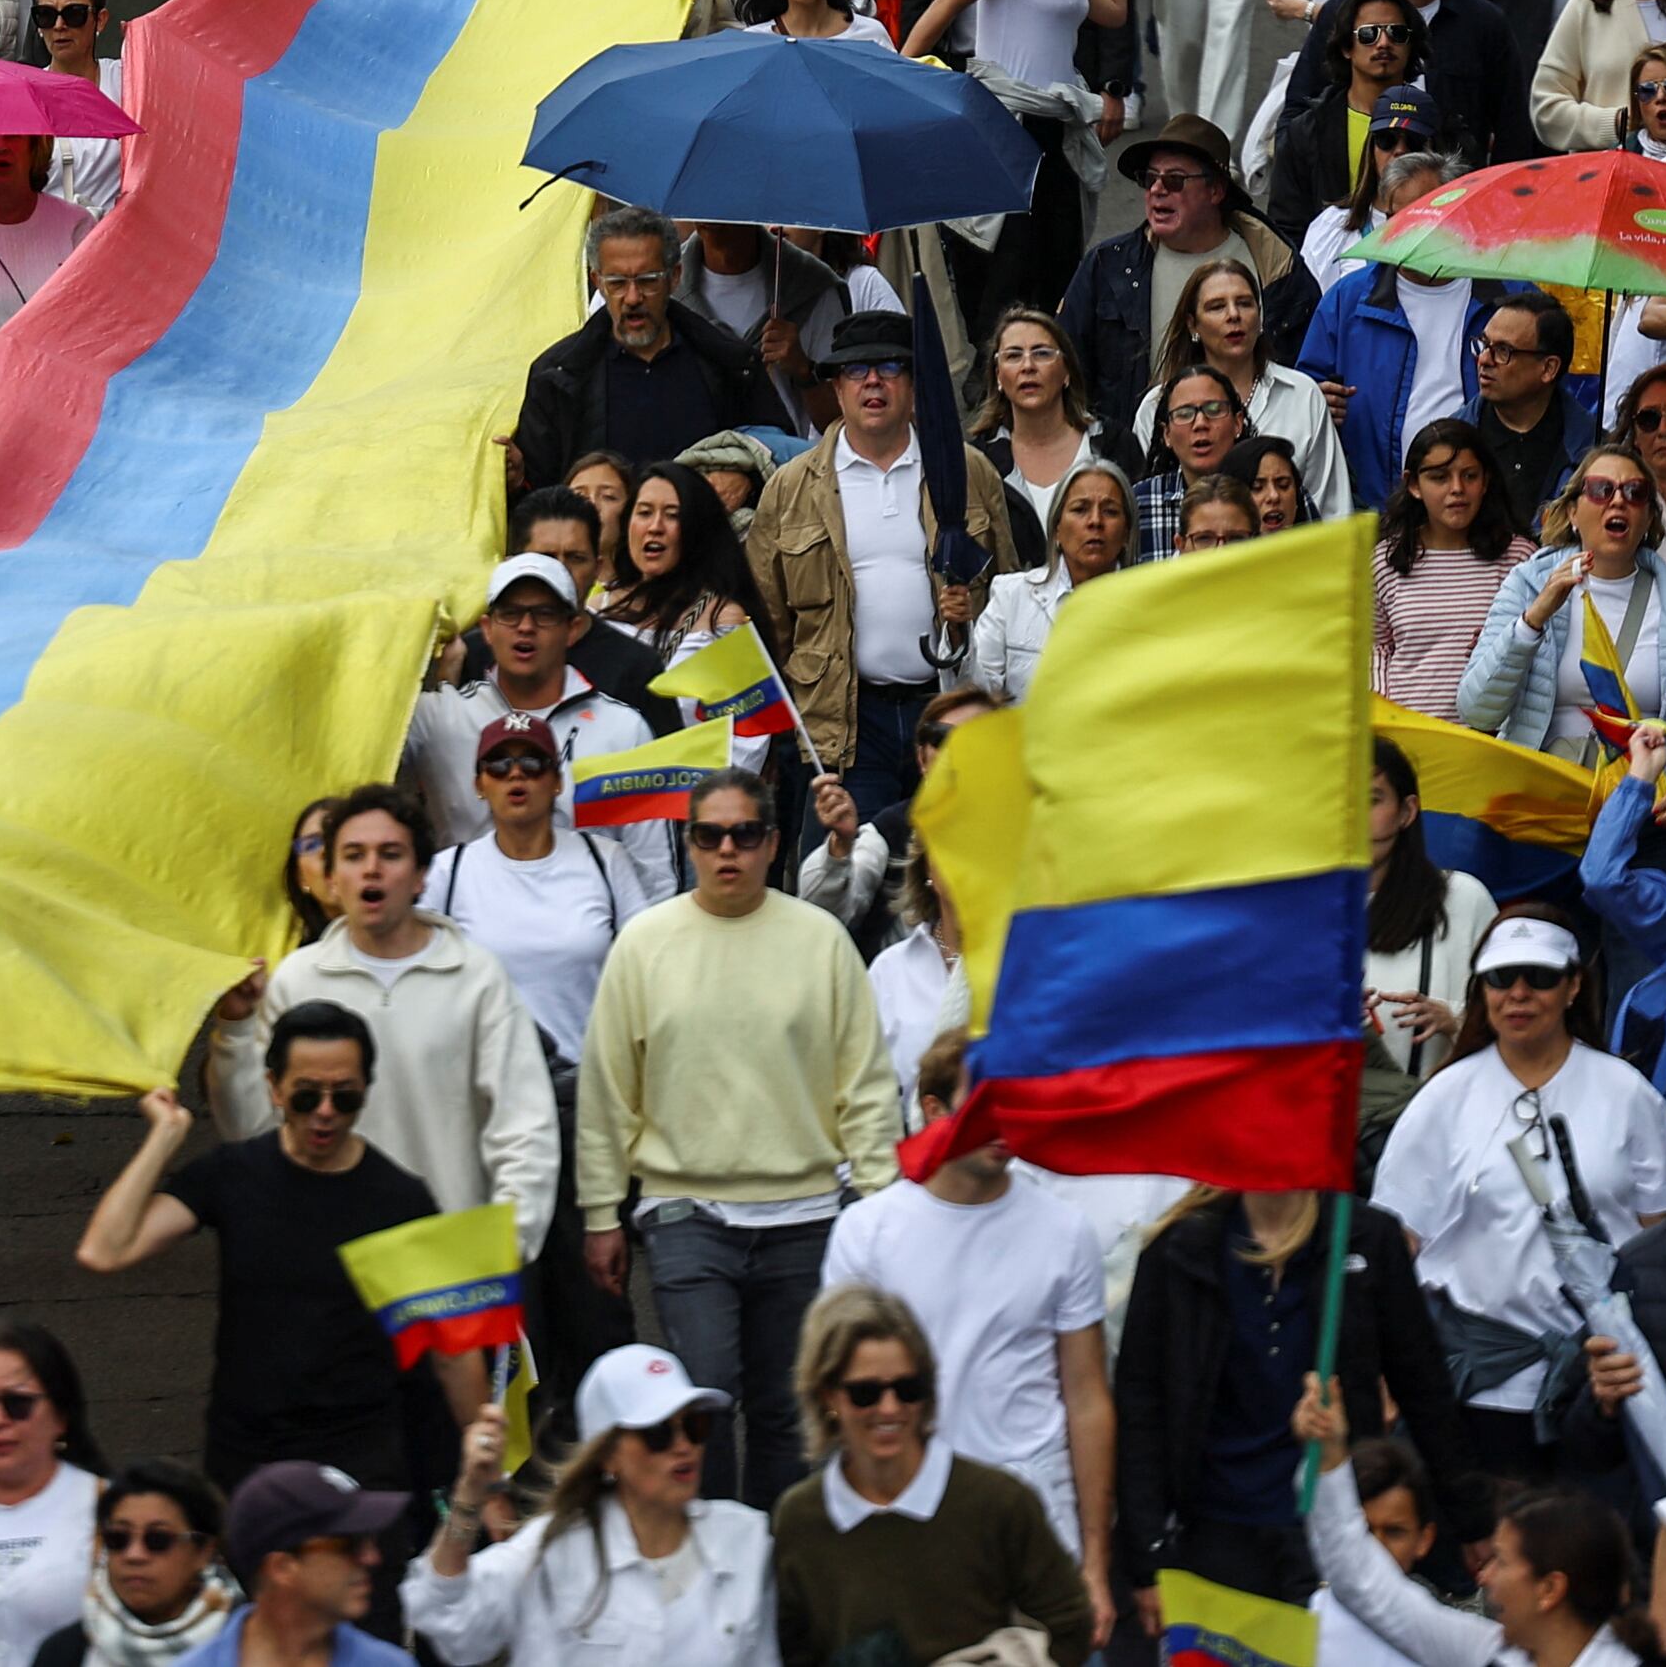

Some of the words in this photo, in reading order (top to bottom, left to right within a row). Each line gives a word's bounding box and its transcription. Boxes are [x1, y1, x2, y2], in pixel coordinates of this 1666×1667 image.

[1620, 232, 1632, 241] La
[1634, 234, 1660, 244] vida,
[504, 713, 531, 732] NY
